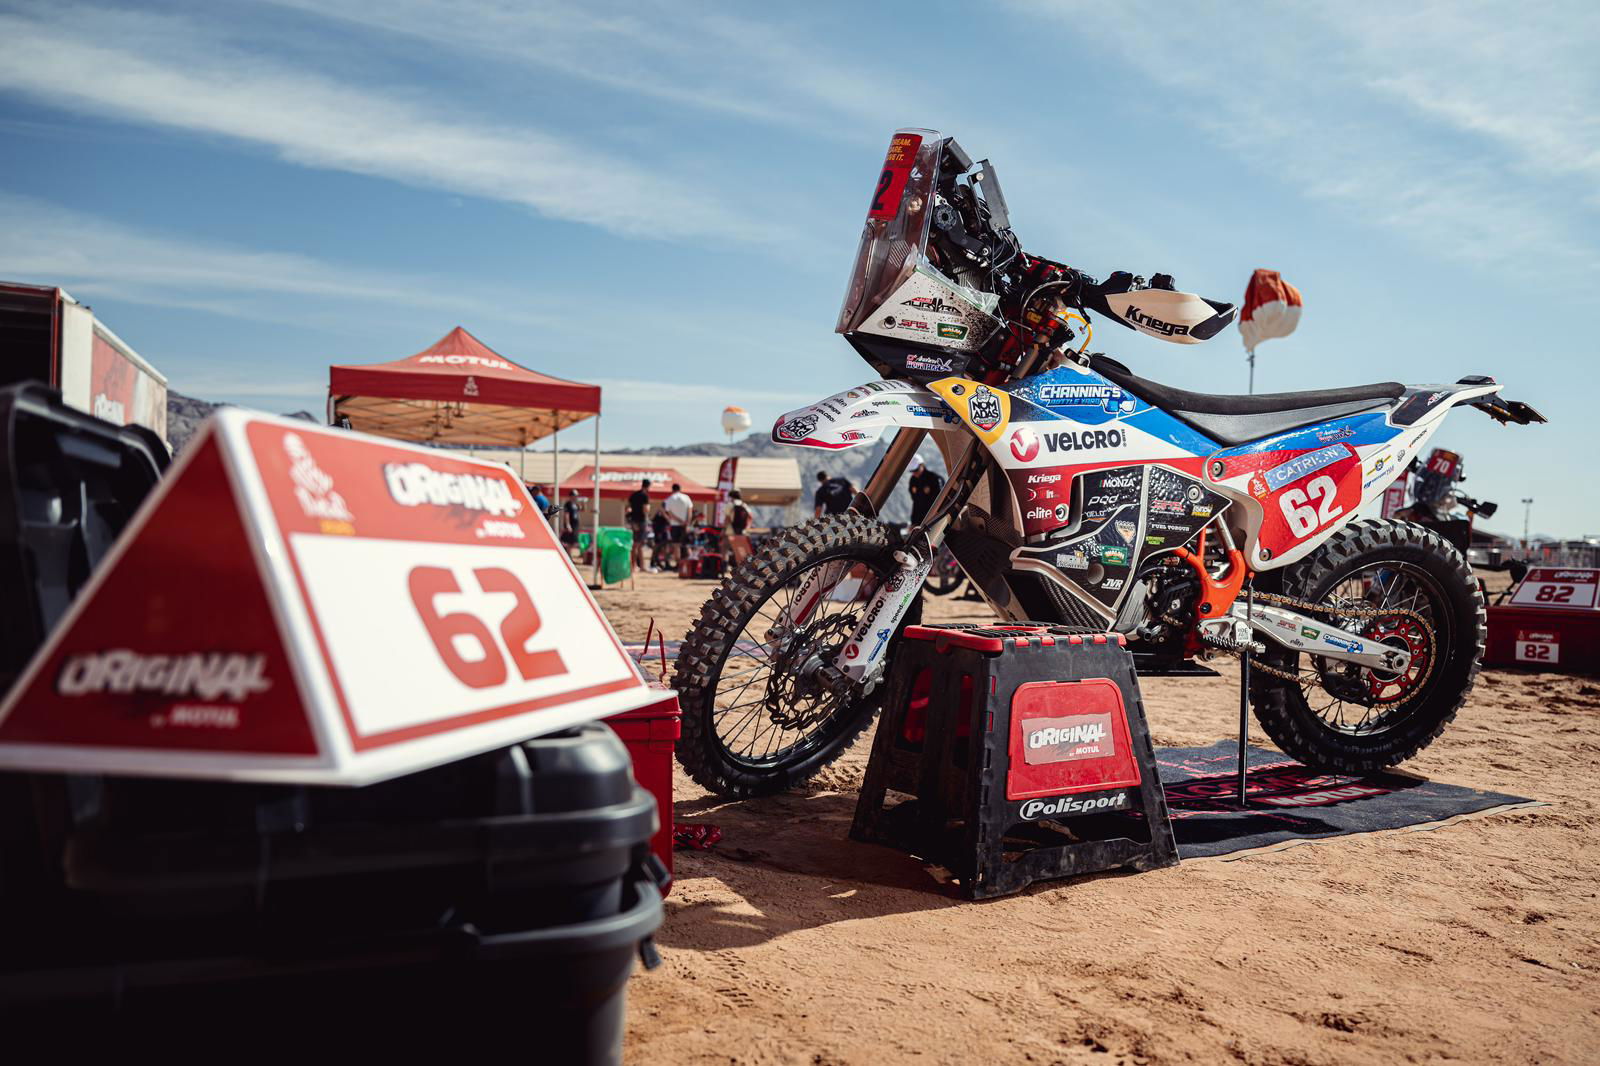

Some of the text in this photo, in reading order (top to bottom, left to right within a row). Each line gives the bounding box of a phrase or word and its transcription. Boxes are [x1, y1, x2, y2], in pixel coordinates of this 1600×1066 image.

[1125, 305, 1189, 336] Kriega
[419, 355, 513, 371] MOTUL
[1041, 386, 1121, 398] CHANNING'S
[974, 409, 999, 419] ADAS
[1432, 458, 1451, 474] 70
[1027, 473, 1062, 484] Kriega
[1103, 478, 1135, 488] MONZA
[1279, 475, 1344, 539] 62
[1101, 578, 1124, 588] JVR
[1535, 585, 1575, 603] 82
[407, 565, 570, 690] 62
[1524, 644, 1551, 660] 82
[57, 648, 272, 700] ORIGINAL
[1029, 723, 1107, 749] ORIGINAL
[1075, 746, 1100, 755] MOTUL
[1023, 792, 1127, 819] Polisport
